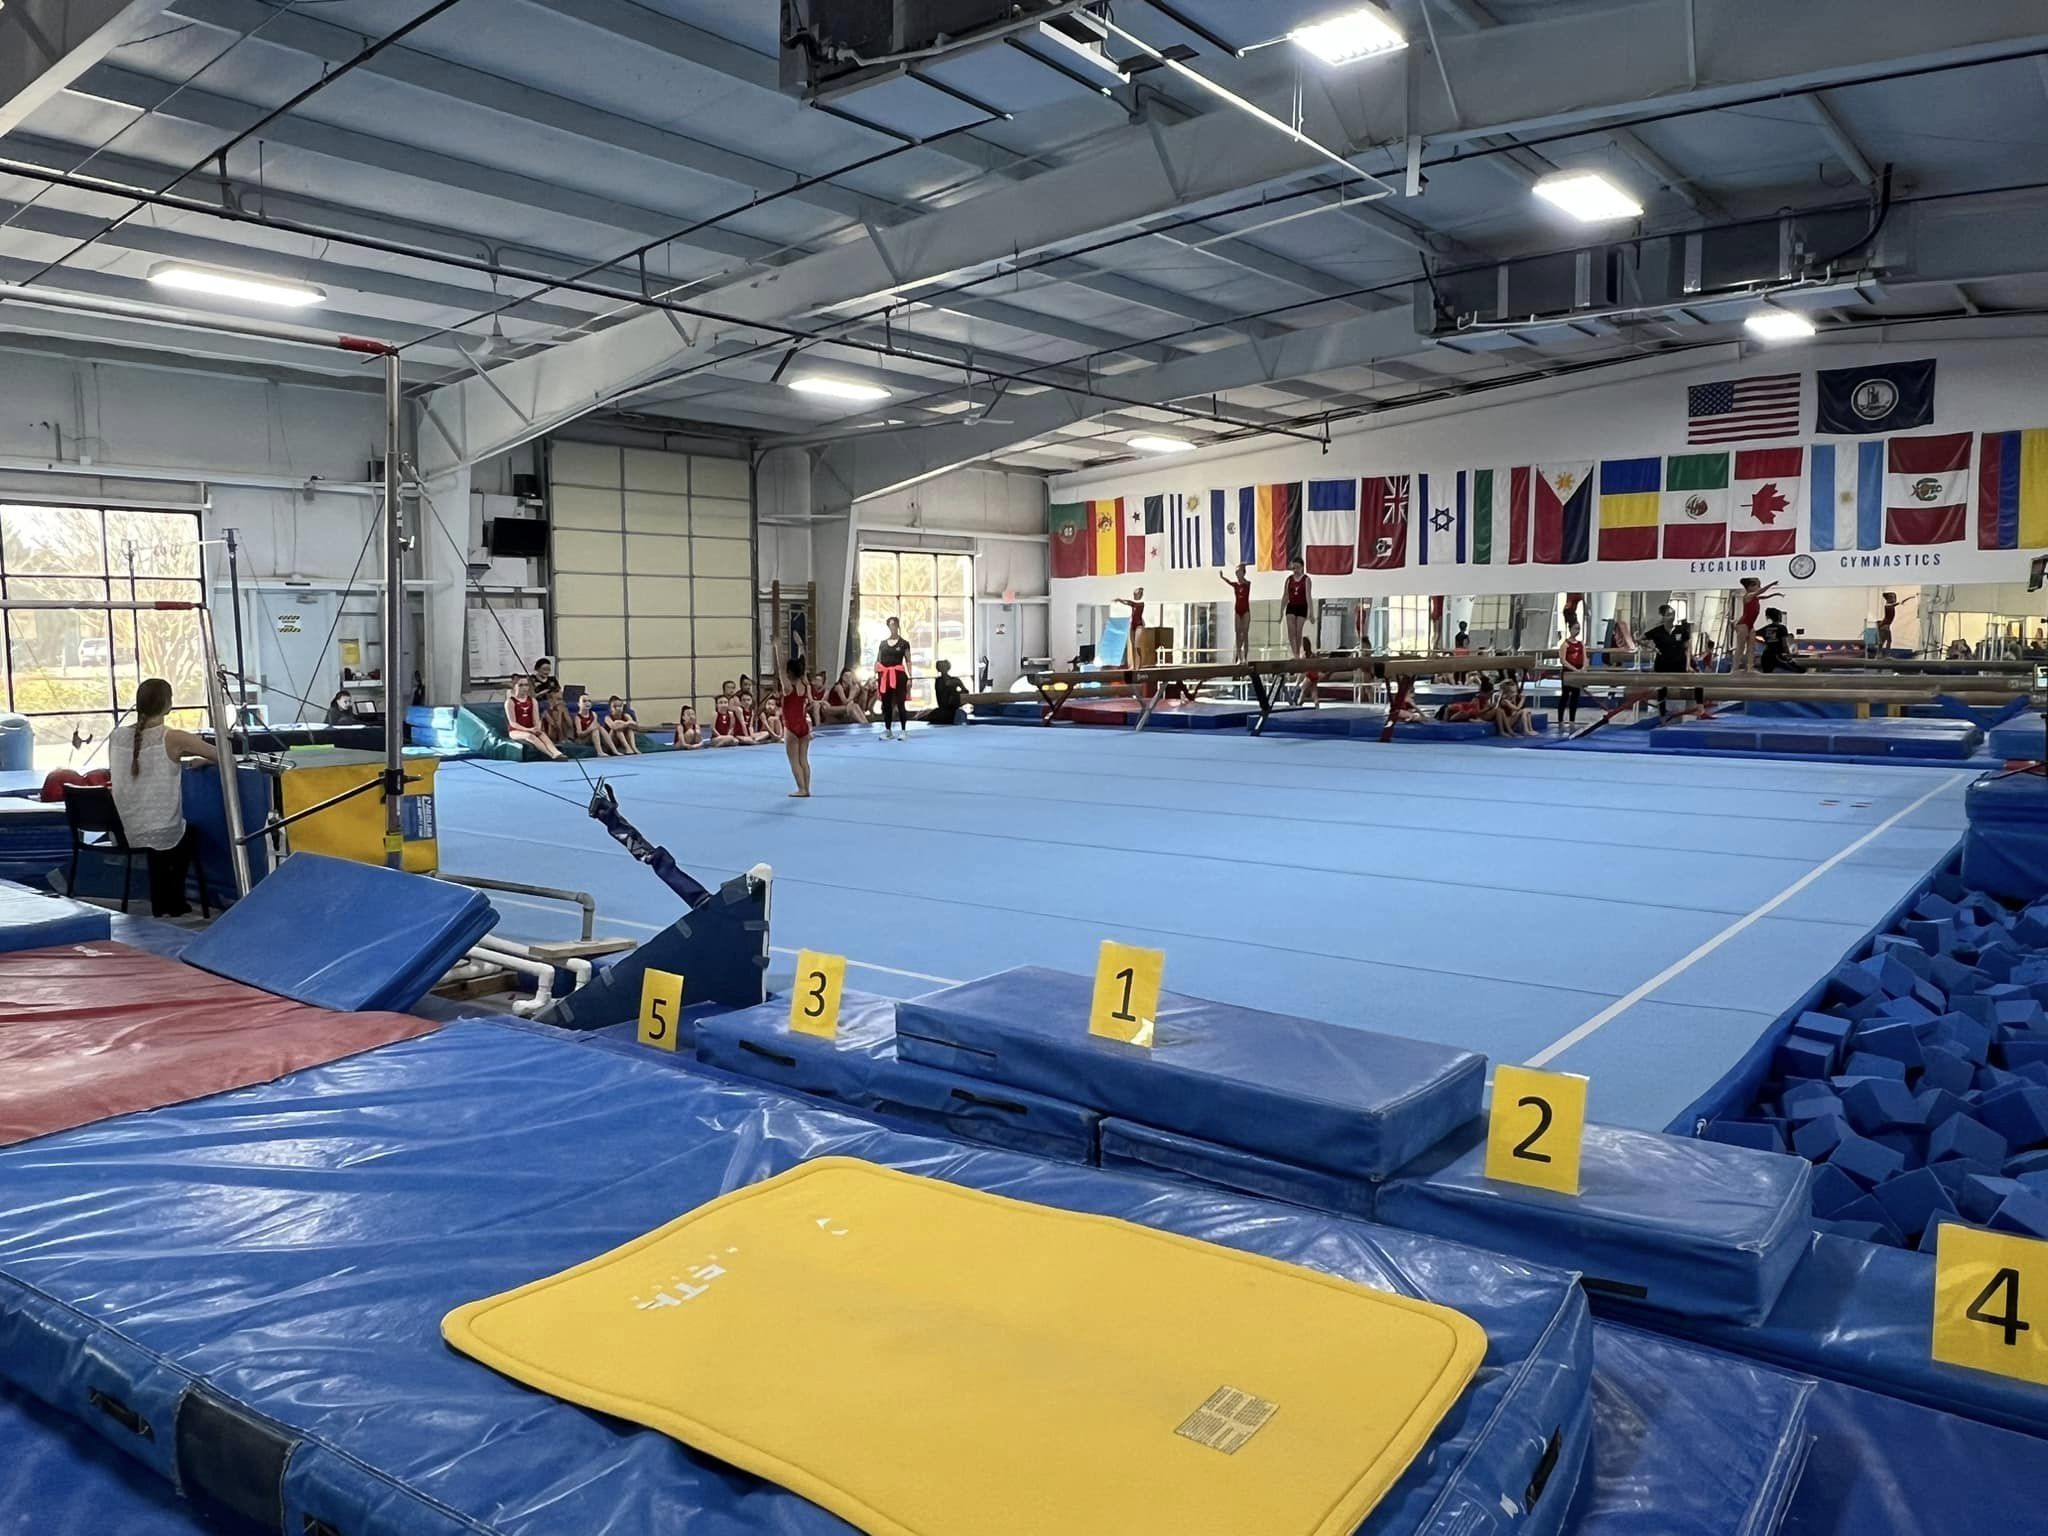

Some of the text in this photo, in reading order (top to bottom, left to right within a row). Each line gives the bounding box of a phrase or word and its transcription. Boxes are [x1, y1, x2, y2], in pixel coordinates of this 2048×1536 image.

[1690, 553, 1941, 573] EXCALIBUR GYMNASTICS
[648, 998, 668, 1040] 5
[803, 971, 827, 1017] 3
[1111, 968, 1136, 1022] 1
[1512, 1096, 1553, 1163] 2
[1966, 1267, 2030, 1346] 4
